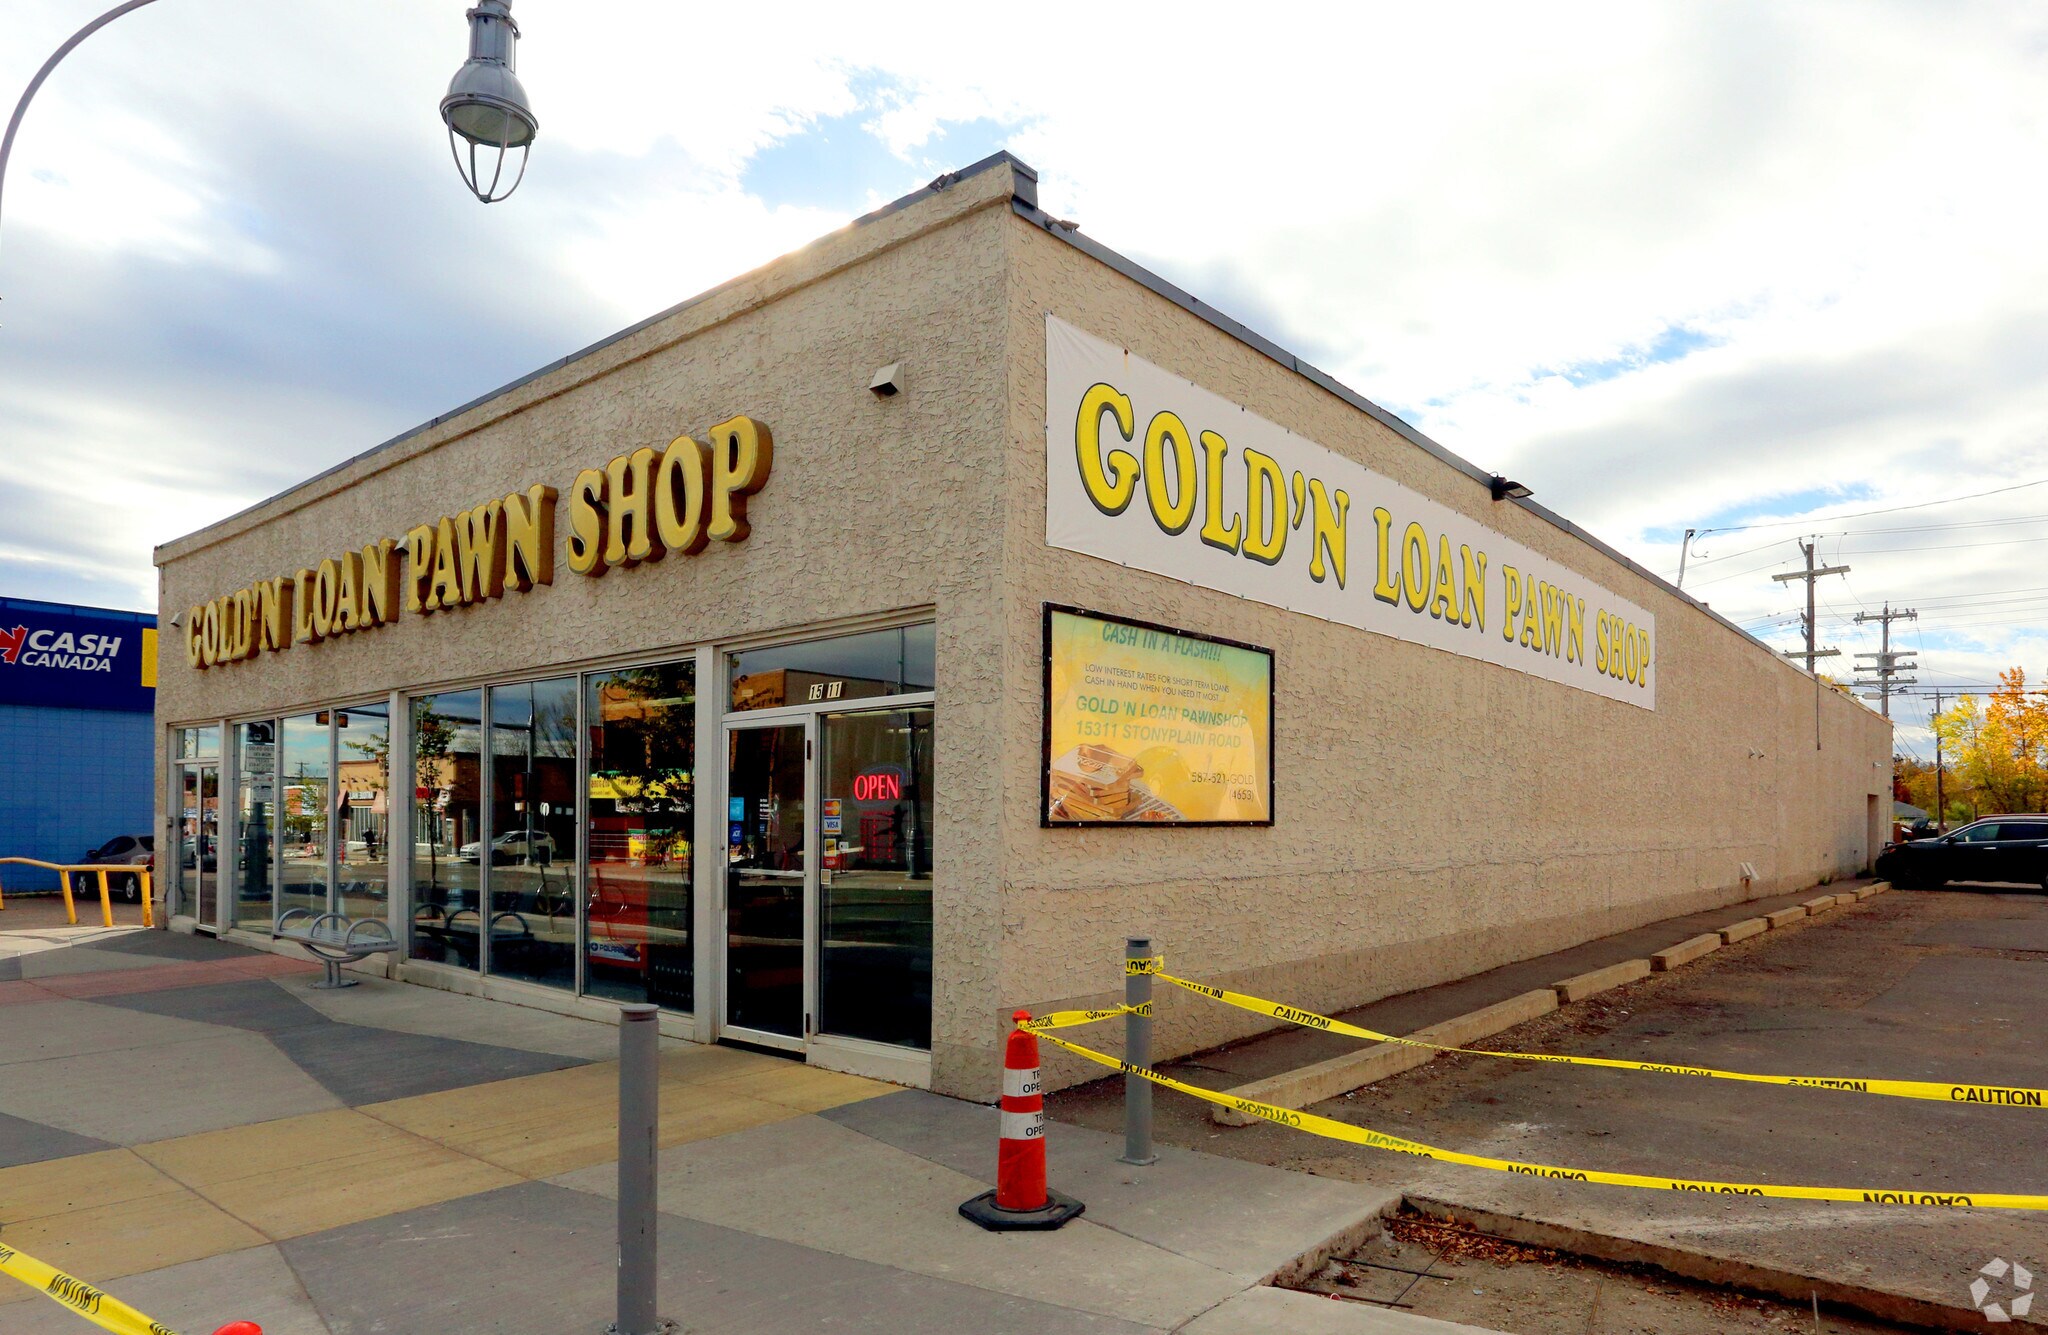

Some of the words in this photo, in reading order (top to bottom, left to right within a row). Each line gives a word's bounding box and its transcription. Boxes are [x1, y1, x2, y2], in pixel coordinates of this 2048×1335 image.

[186, 576, 294, 670] GOLD'N
[295, 538, 399, 645] LOAN
[405, 484, 558, 614] PAWN
[566, 415, 773, 578] SHOP
[1074, 381, 1350, 590] GOLD'N
[1373, 507, 1488, 633] LOAN
[1501, 564, 1586, 666] PAWN
[1595, 608, 1651, 689] SHOP
[28, 629, 122, 657] CASH
[1102, 623, 1139, 647] CASH
[1142, 631, 1159, 650] IN
[1161, 634, 1170, 653] A
[21, 651, 112, 672] CANADA
[1085, 664, 1103, 673] LOW
[1104, 666, 1136, 679] INTEREST
[1137, 671, 1157, 682] RATES
[1157, 674, 1171, 685] FOR
[1172, 677, 1194, 688] SHORT
[1195, 680, 1210, 690] TERM
[1210, 683, 1230, 693] LOANS
[1085, 675, 1105, 686] CASH
[1106, 679, 1115, 687] IN
[1117, 680, 1138, 691] HAND
[1140, 683, 1160, 694] WHEN
[1162, 686, 1177, 696] YOU
[1178, 689, 1195, 698] NEED
[1195, 691, 1202, 699] IT
[1076, 695, 1119, 714] GOLD
[1140, 703, 1178, 721] LOAN
[1182, 708, 1248, 729] PAWNSHOP
[1076, 720, 1118, 737] 15311
[1122, 724, 1205, 746] STONYPLAIN
[1208, 733, 1242, 749] ROAD
[853, 774, 899, 801] OPEN
[826, 821, 839, 829] VISA
[1273, 1006, 1331, 1029] CAUTION
[1950, 1086, 2042, 1107] CAUTION
